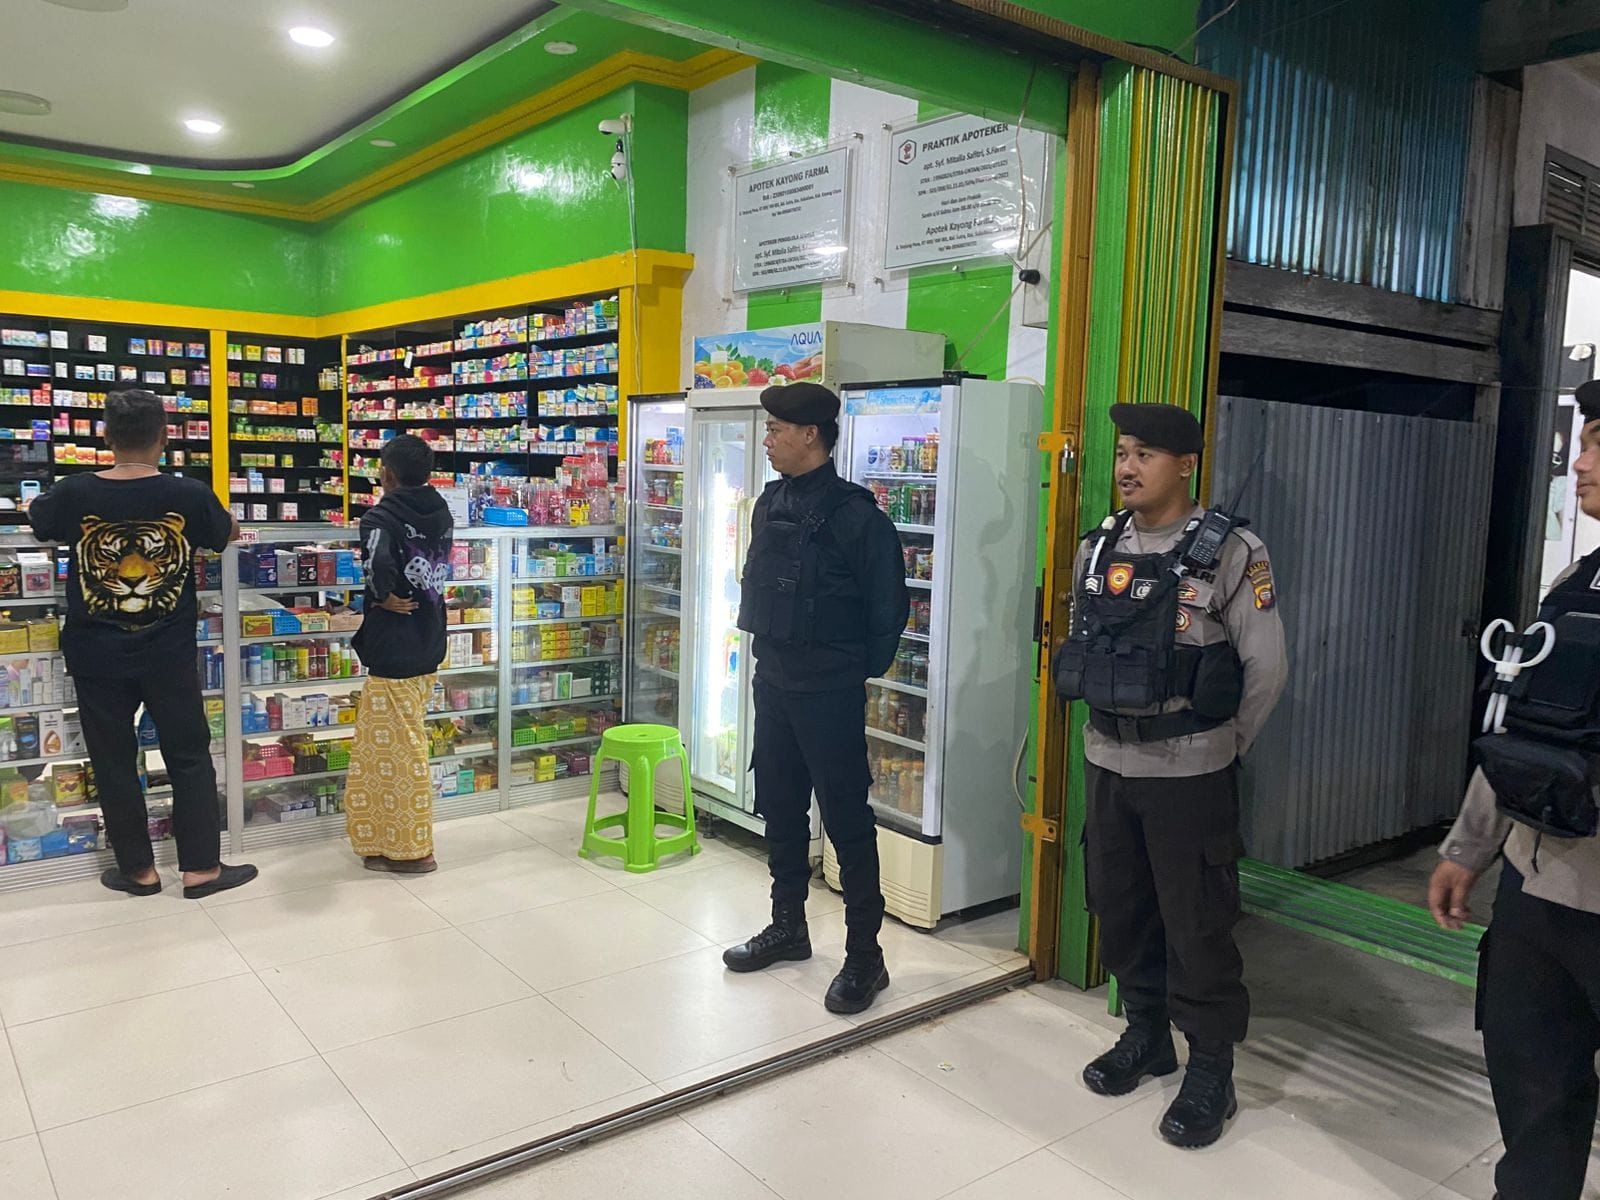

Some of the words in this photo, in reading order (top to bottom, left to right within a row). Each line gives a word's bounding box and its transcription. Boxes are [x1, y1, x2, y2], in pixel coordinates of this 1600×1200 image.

[922, 135, 960, 152] PRAKTIK
[961, 123, 1009, 142] APOTEKER
[748, 179, 775, 193] APOTEK
[775, 172, 803, 186] KAYONG
[804, 165, 829, 179] FARMA
[791, 331, 822, 346] AQUA
